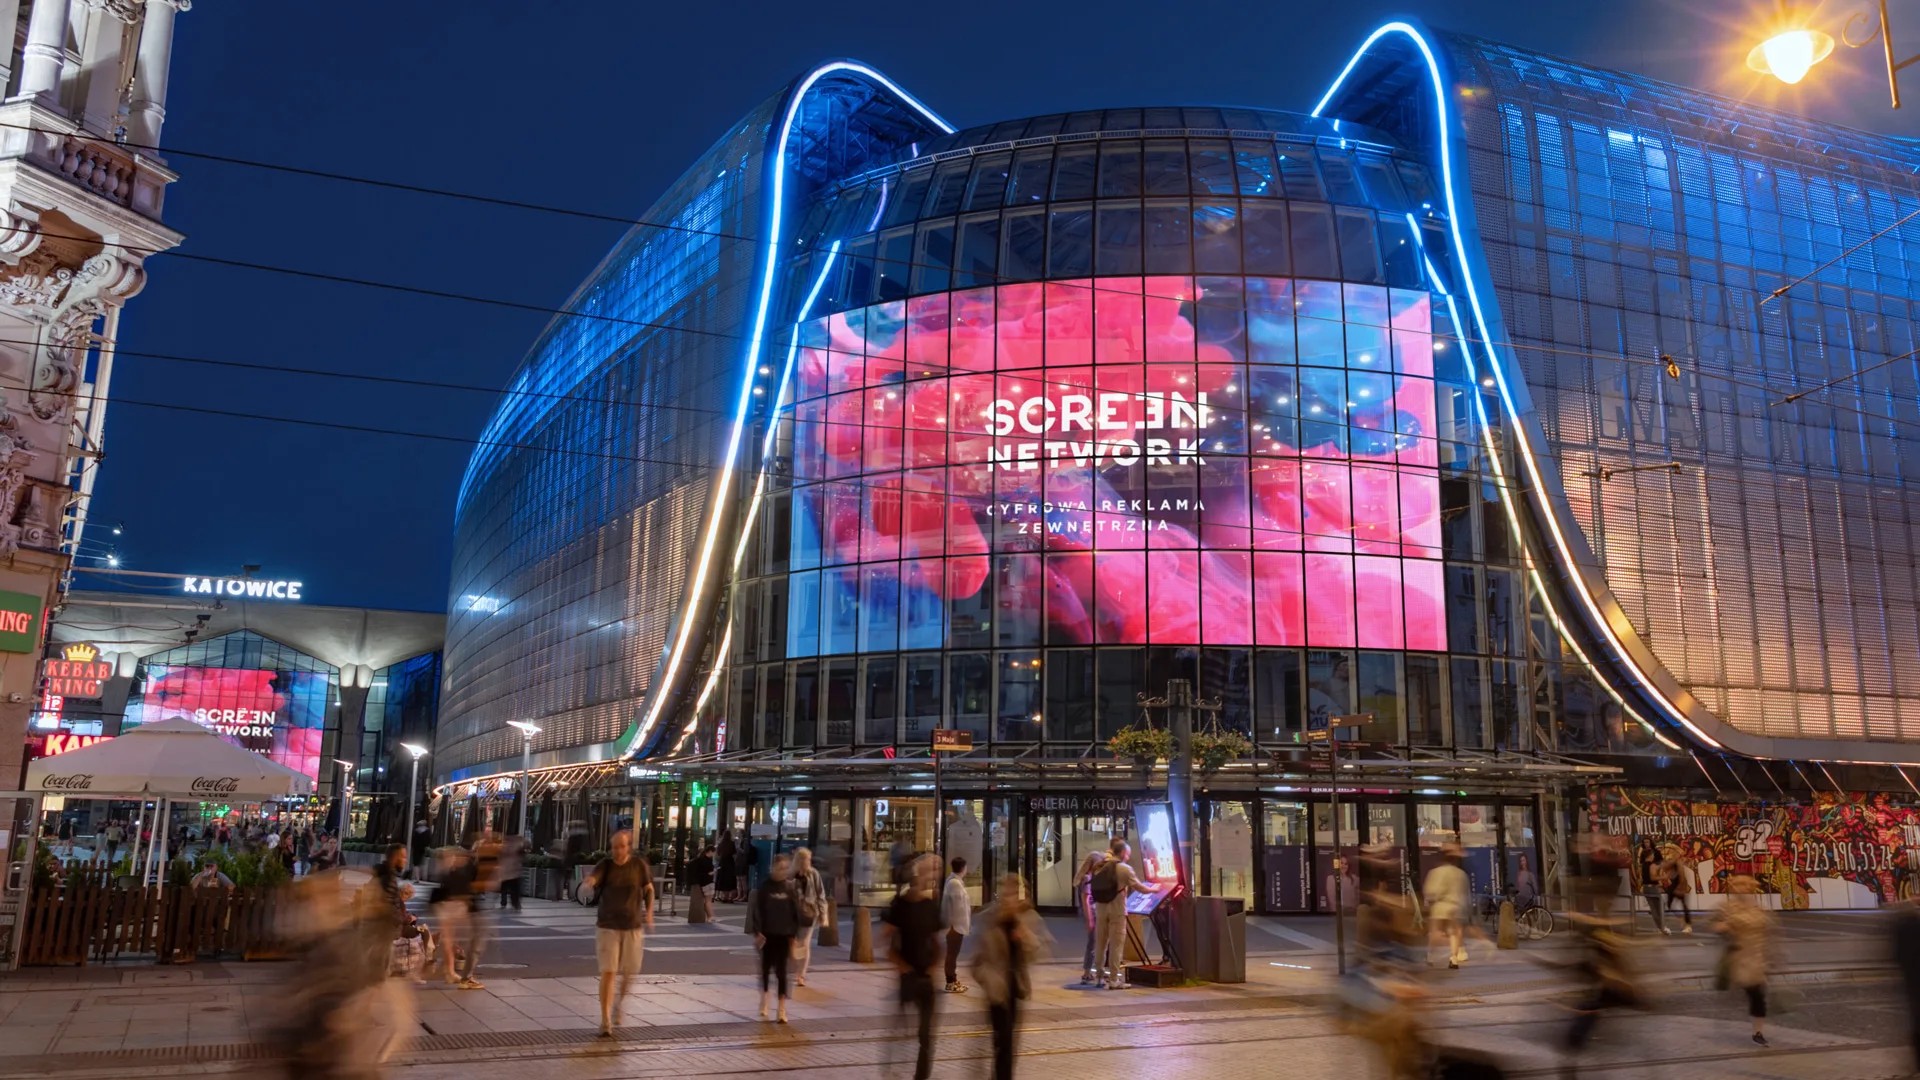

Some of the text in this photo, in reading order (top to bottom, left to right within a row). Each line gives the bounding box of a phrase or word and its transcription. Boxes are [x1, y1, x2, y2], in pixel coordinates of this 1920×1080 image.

[986, 438, 1207, 472] NETWORK
[986, 499, 1205, 516] CYFROWA REKLAMA
[1018, 519, 1169, 534] ZEWNĘTRZNA
[184, 577, 302, 599] KATOWICE
[0, 610, 29, 634] ING
[47, 661, 109, 680] KEBAB
[52, 678, 97, 696] KING
[201, 724, 274, 737] TWORK
[45, 734, 113, 756] KAN
[42, 774, 94, 789] Coca-Cola
[191, 776, 240, 792] Coca-Cola
[1030, 797, 1132, 810] GALERIA KATOWI
[1735, 819, 1774, 861] 32
